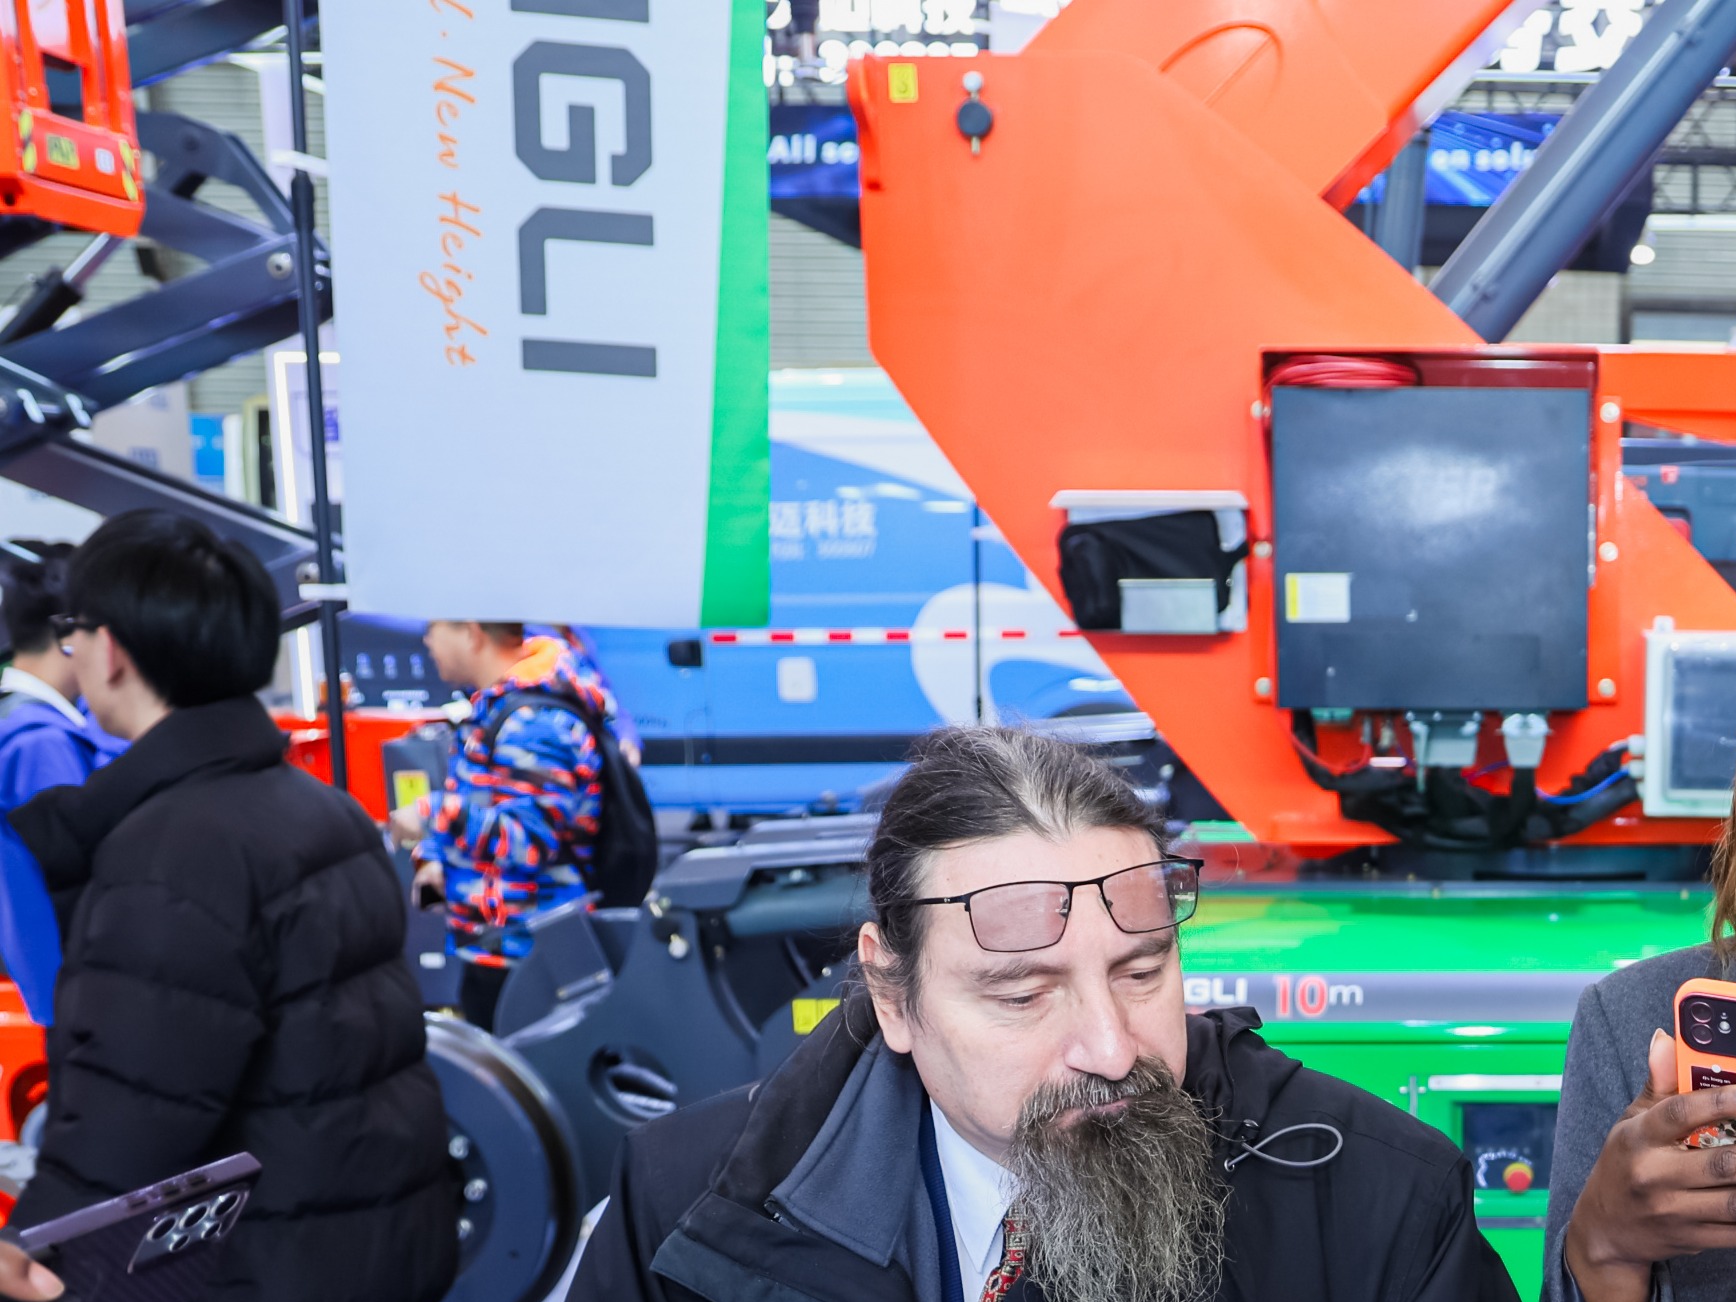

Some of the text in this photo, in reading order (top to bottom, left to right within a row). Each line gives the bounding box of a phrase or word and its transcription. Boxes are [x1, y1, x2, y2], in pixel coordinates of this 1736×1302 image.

[433, 57, 476, 170] New
[767, 134, 817, 165] All
[510, 0, 657, 377] GLI
[419, 190, 489, 368] Height
